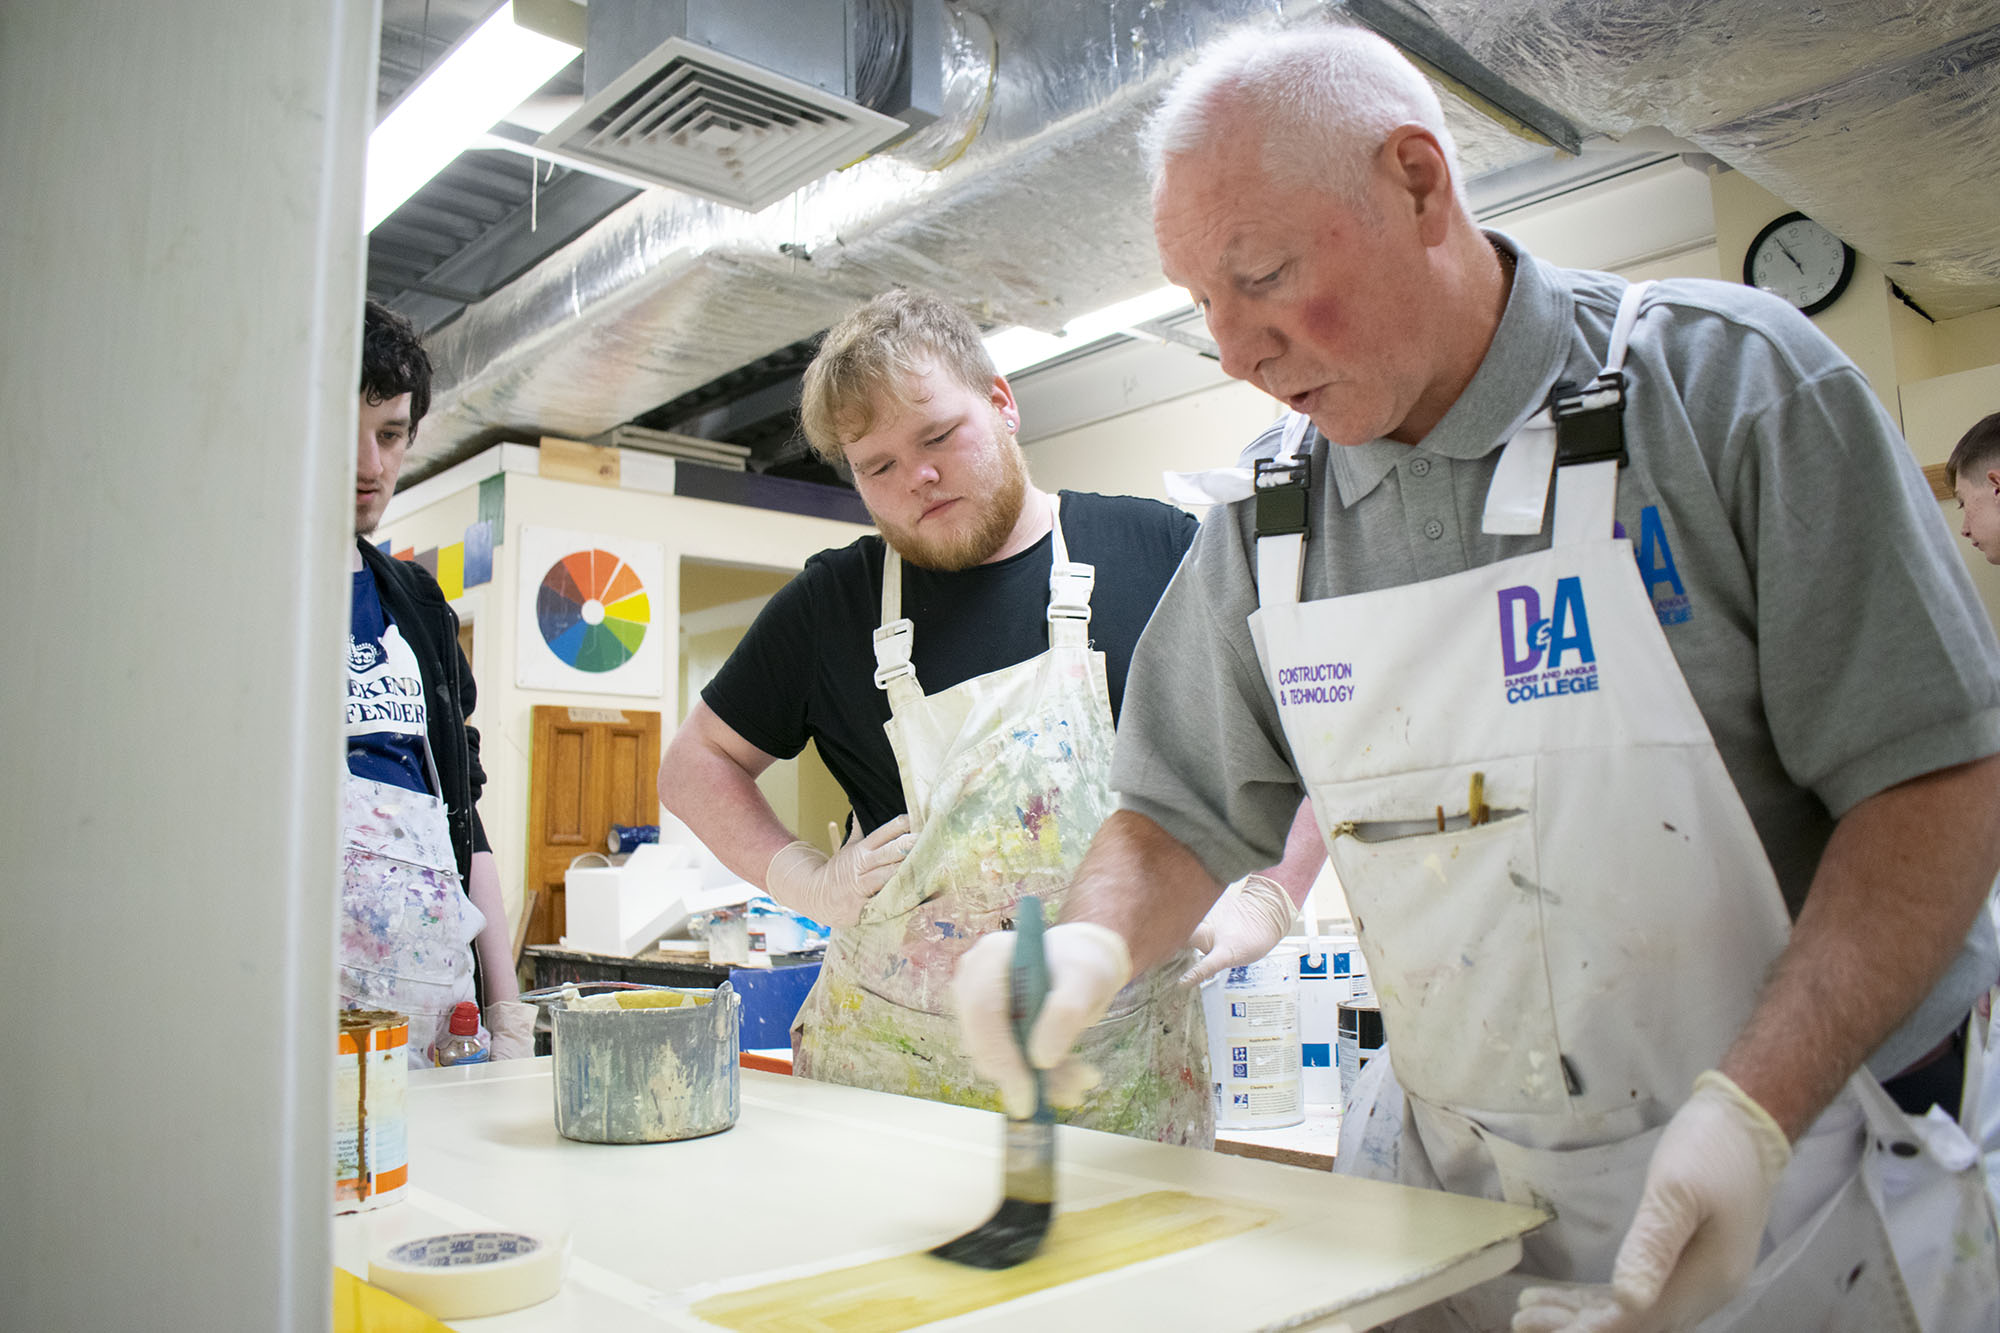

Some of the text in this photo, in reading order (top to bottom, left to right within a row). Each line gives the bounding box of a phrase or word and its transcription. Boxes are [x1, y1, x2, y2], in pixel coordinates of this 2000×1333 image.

[1497, 576, 1596, 677] D&A
[1504, 664, 1597, 688] DUNDEE AND ANGUS
[1506, 674, 1599, 704] COLLEGE
